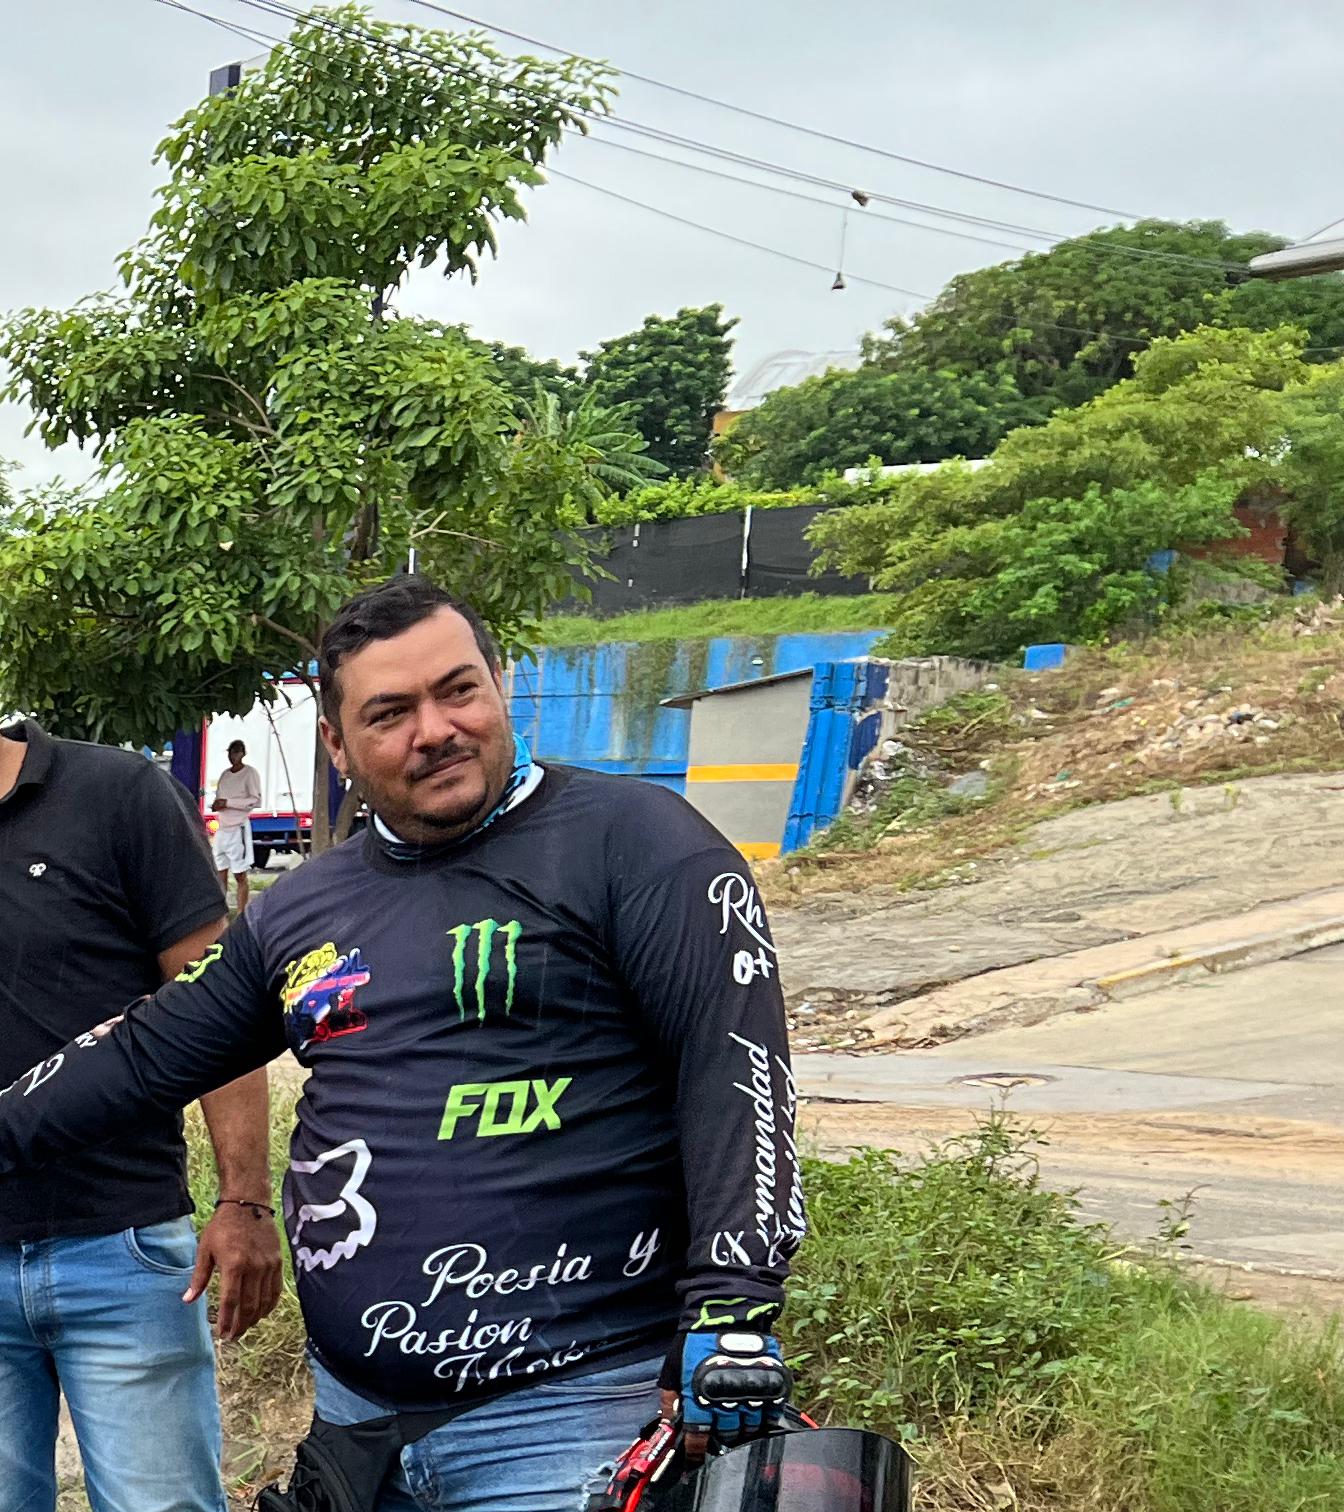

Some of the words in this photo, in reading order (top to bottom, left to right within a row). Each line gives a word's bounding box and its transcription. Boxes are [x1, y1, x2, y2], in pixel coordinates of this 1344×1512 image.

[437, 1077, 573, 1141] FOX
[421, 1242, 594, 1307] Poesia
[622, 1228, 661, 1277] y
[361, 1300, 534, 1357] Pasion
